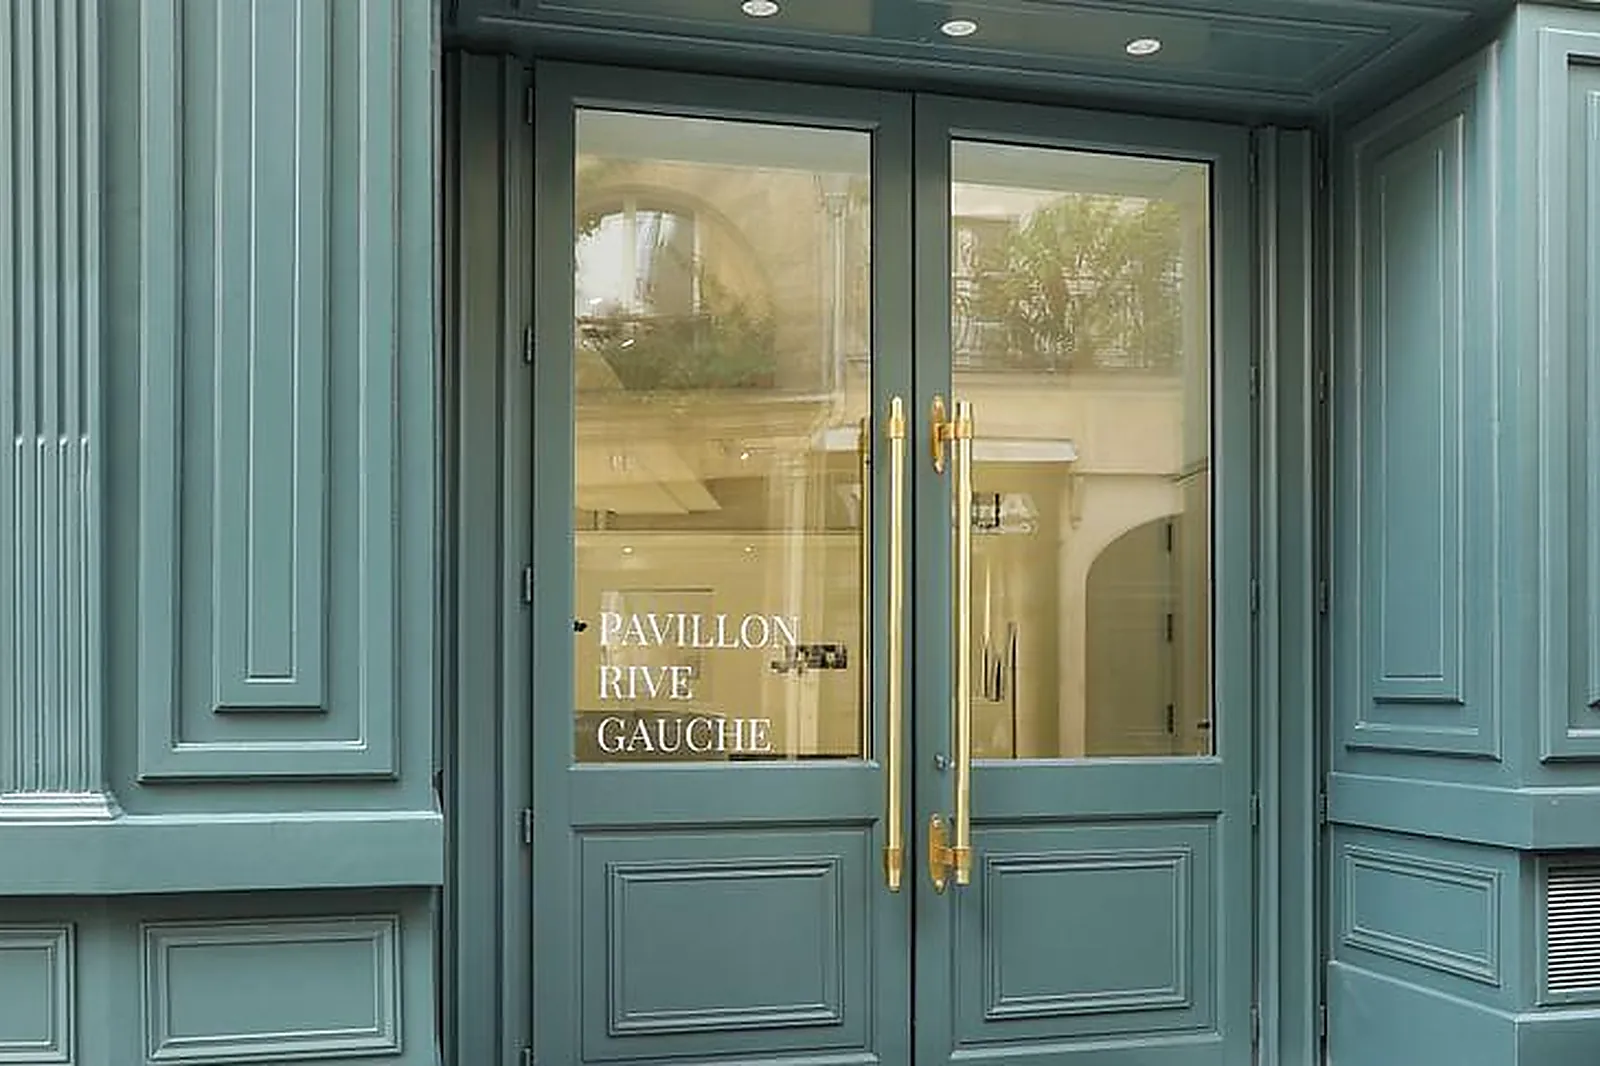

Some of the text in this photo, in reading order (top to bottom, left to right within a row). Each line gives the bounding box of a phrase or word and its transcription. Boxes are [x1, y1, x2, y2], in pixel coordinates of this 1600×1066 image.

[599, 611, 800, 650] PAVILLON
[599, 665, 694, 700] RIVE
[597, 716, 774, 754] GAUCHE
